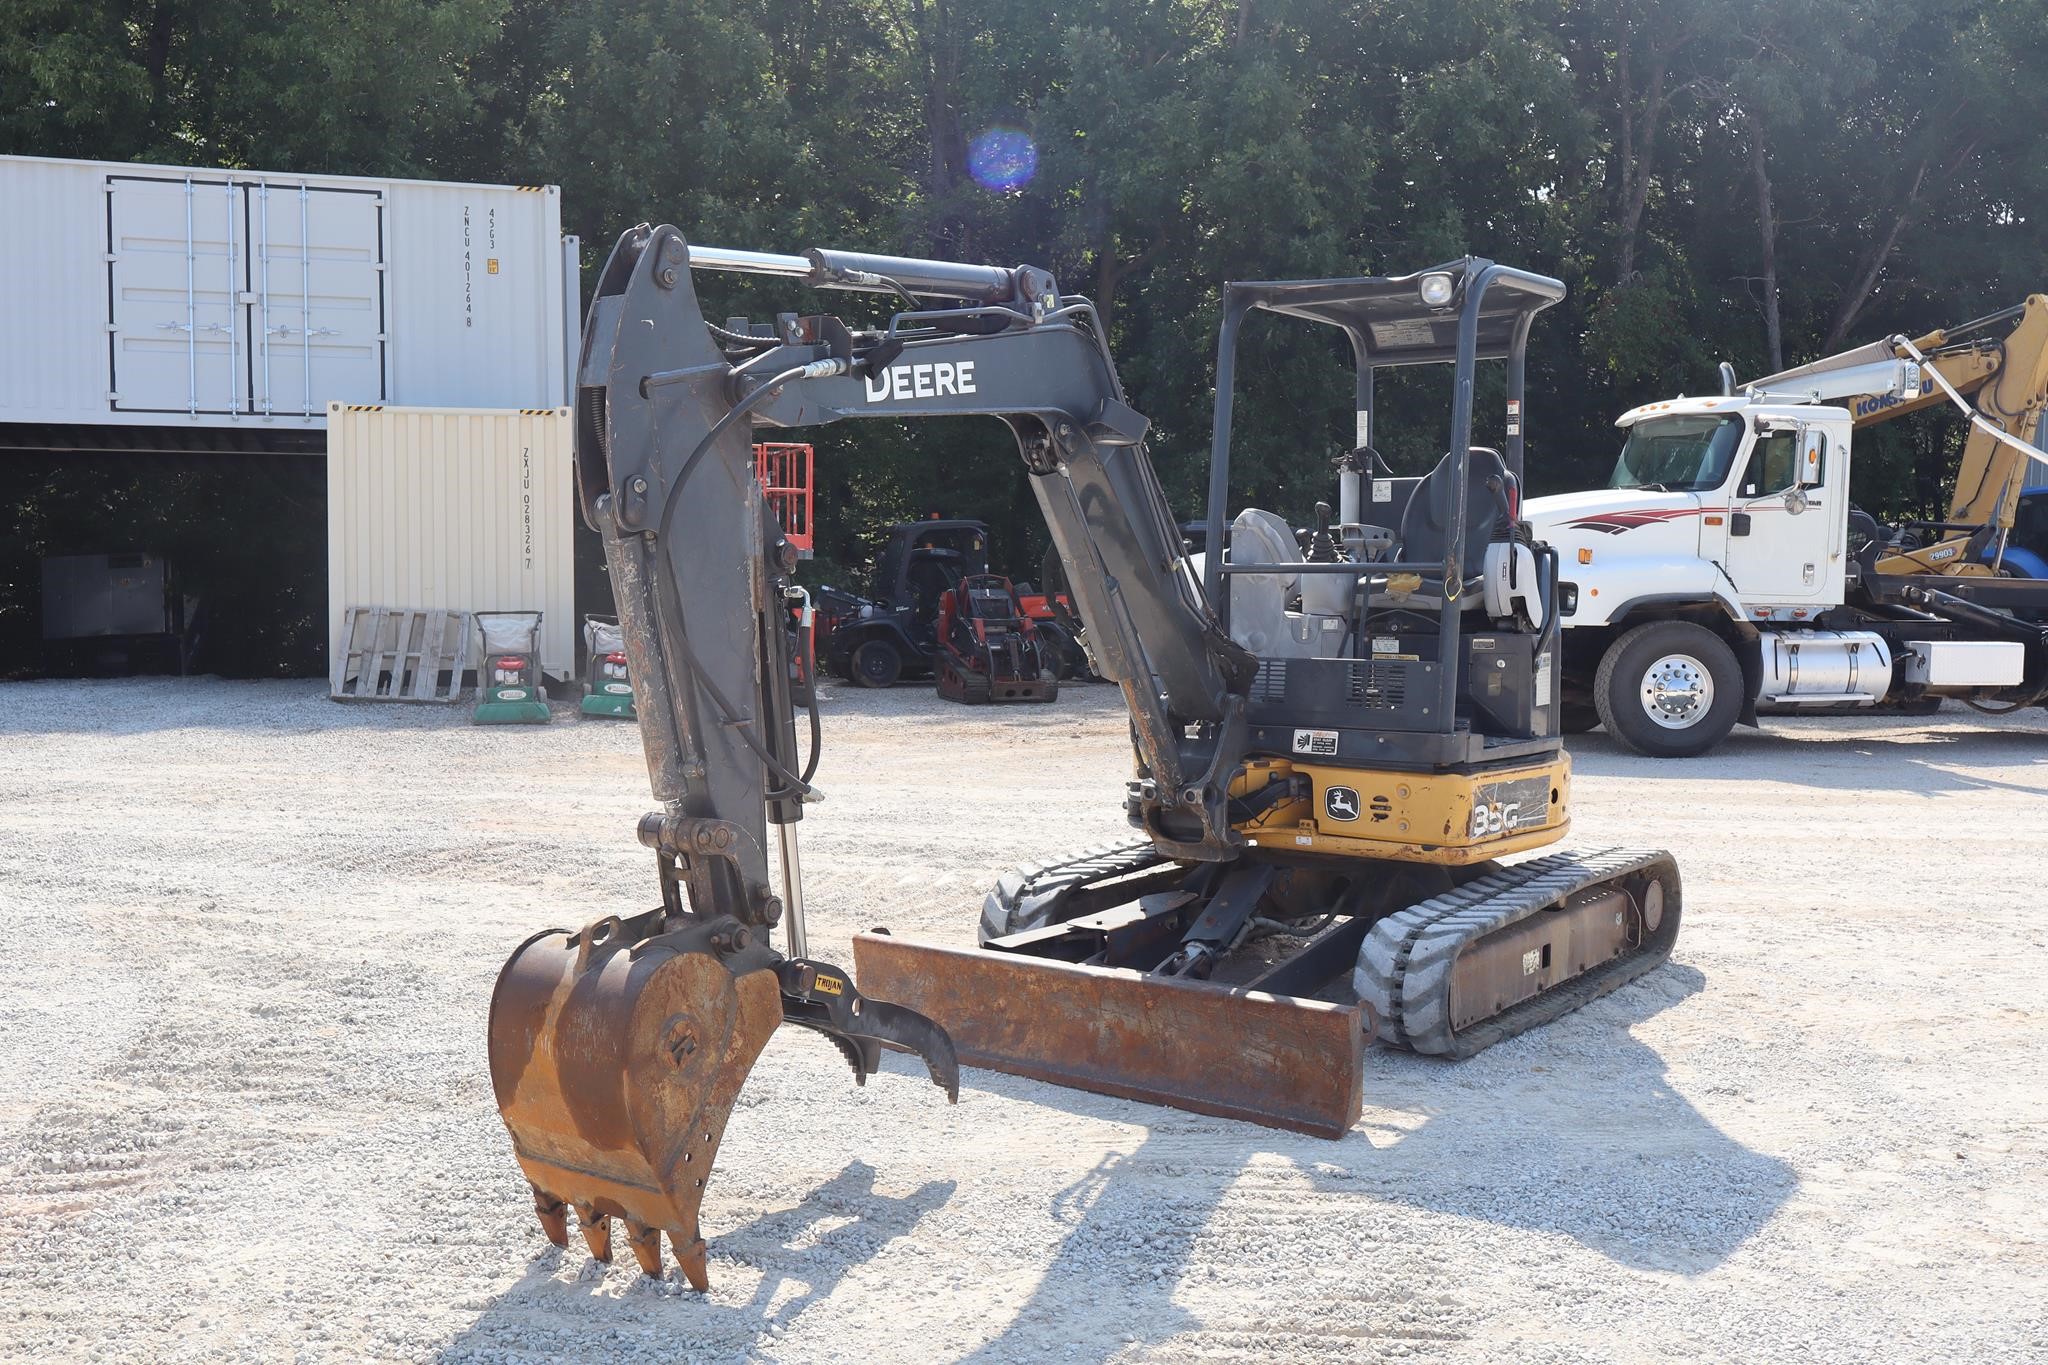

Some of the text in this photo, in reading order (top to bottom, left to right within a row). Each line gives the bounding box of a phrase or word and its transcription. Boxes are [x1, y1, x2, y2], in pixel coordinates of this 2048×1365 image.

[865, 361, 976, 402] DEERE
[523, 494, 531, 554] 028326
[817, 977, 842, 990] TROJAN
